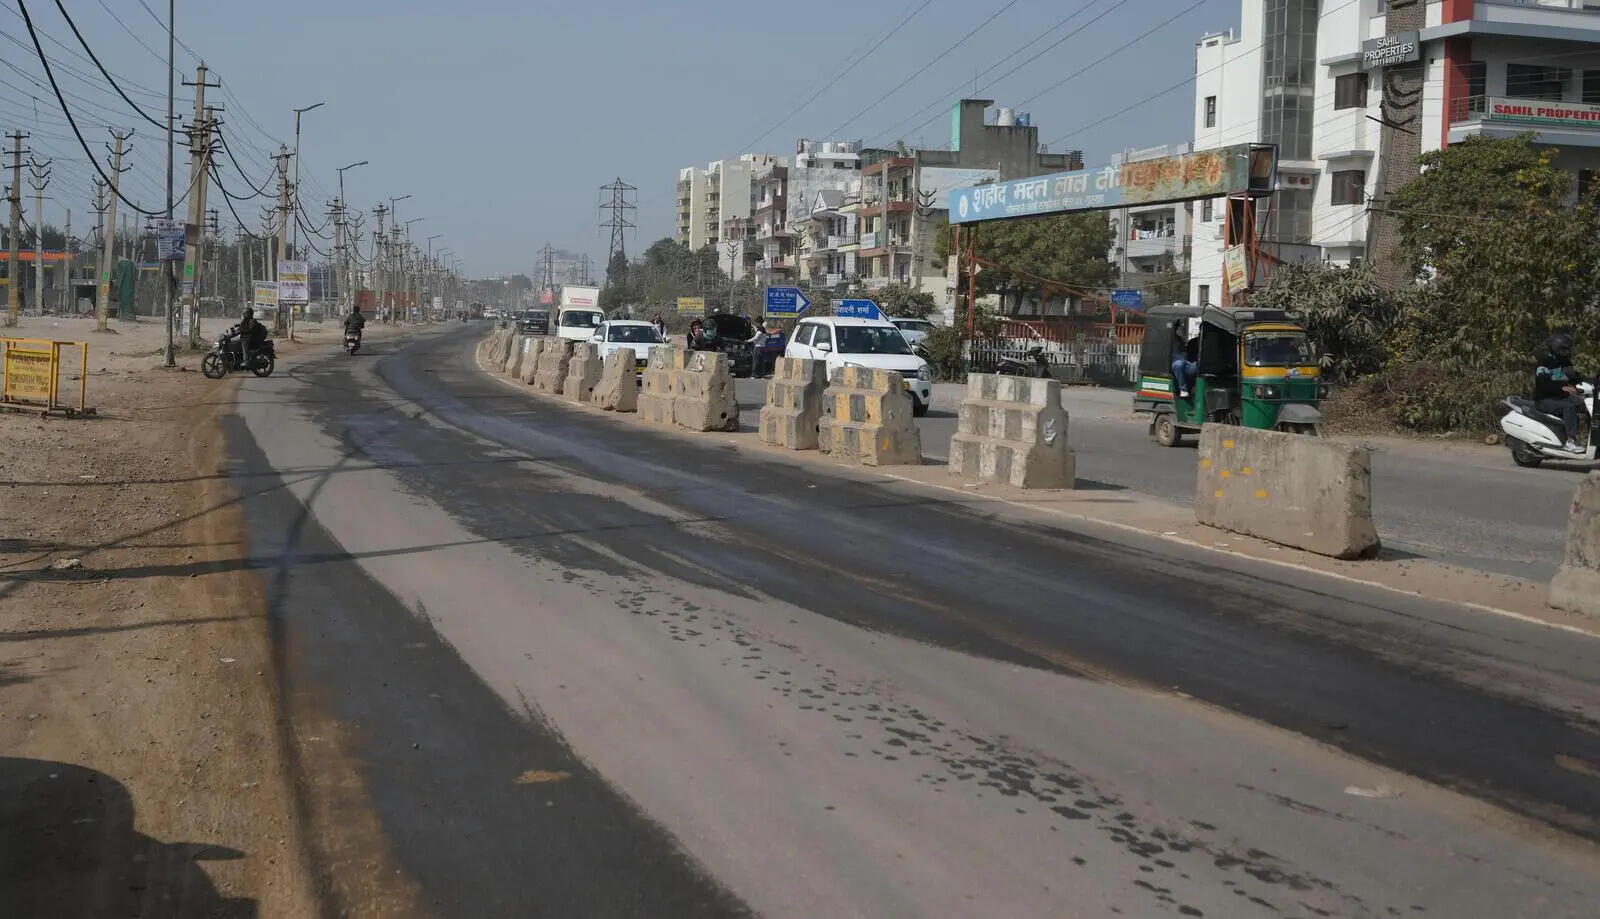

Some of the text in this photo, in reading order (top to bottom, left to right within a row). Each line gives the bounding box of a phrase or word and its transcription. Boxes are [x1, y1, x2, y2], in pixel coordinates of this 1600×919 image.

[1377, 36, 1400, 48] SAHIL
[1364, 43, 1413, 61] PROPERTIES
[1494, 104, 1534, 116] SAHIL
[973, 183, 1008, 213] शहीद
[1013, 178, 1049, 201] मदन
[1055, 174, 1090, 196] लाल
[36, 375, 50, 387] POLIC
